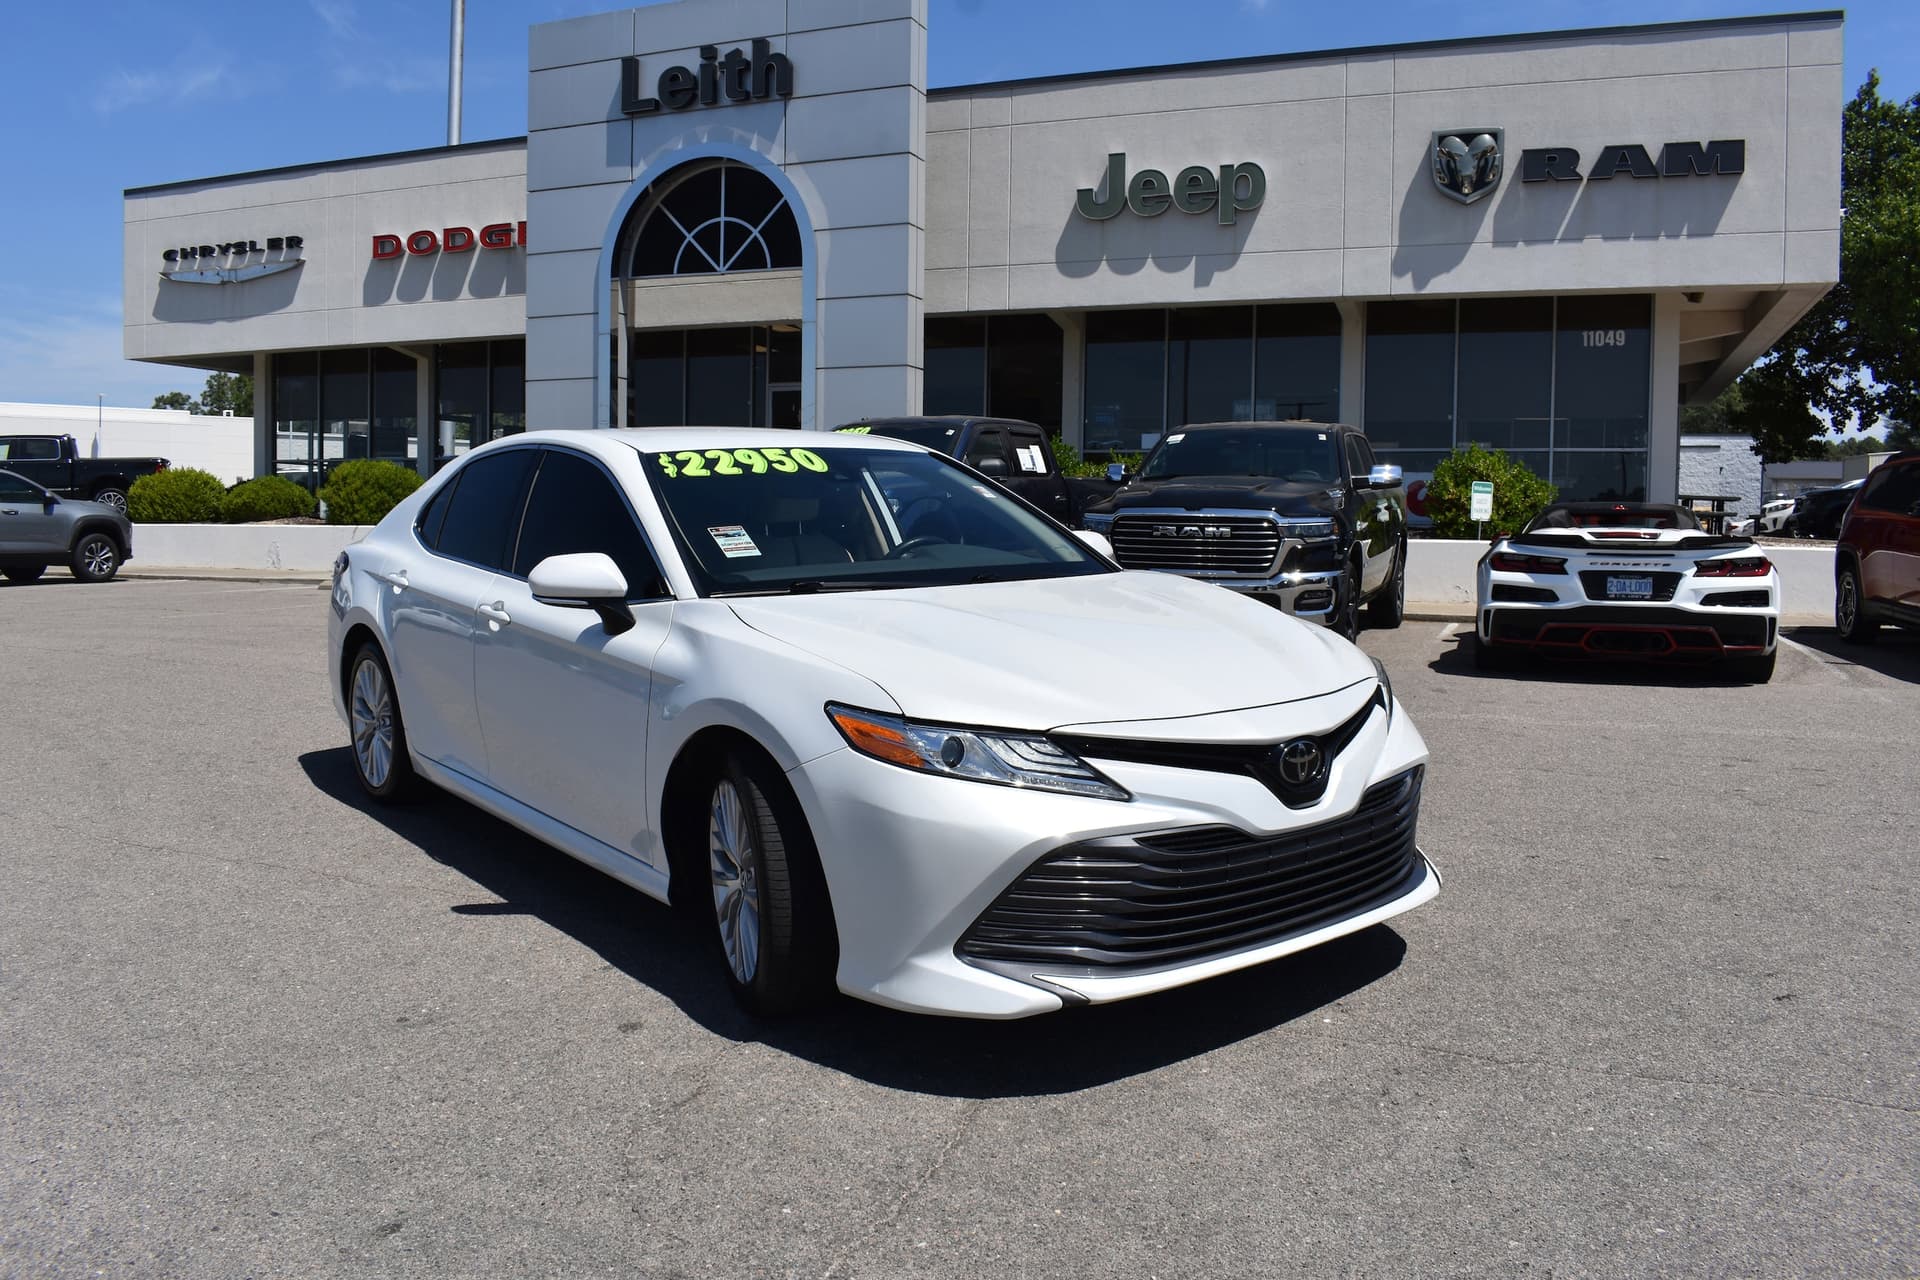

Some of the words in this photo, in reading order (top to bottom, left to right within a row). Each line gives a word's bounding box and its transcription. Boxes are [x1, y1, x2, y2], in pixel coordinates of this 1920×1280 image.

[621, 38, 793, 115] Leith
[1522, 139, 1745, 182] RAM
[1076, 152, 1266, 225] Jeep
[163, 235, 303, 261] CHRYSLER
[1582, 330, 1626, 347] 11049
[658, 447, 829, 479] $22950
[1152, 525, 1231, 538] RAM
